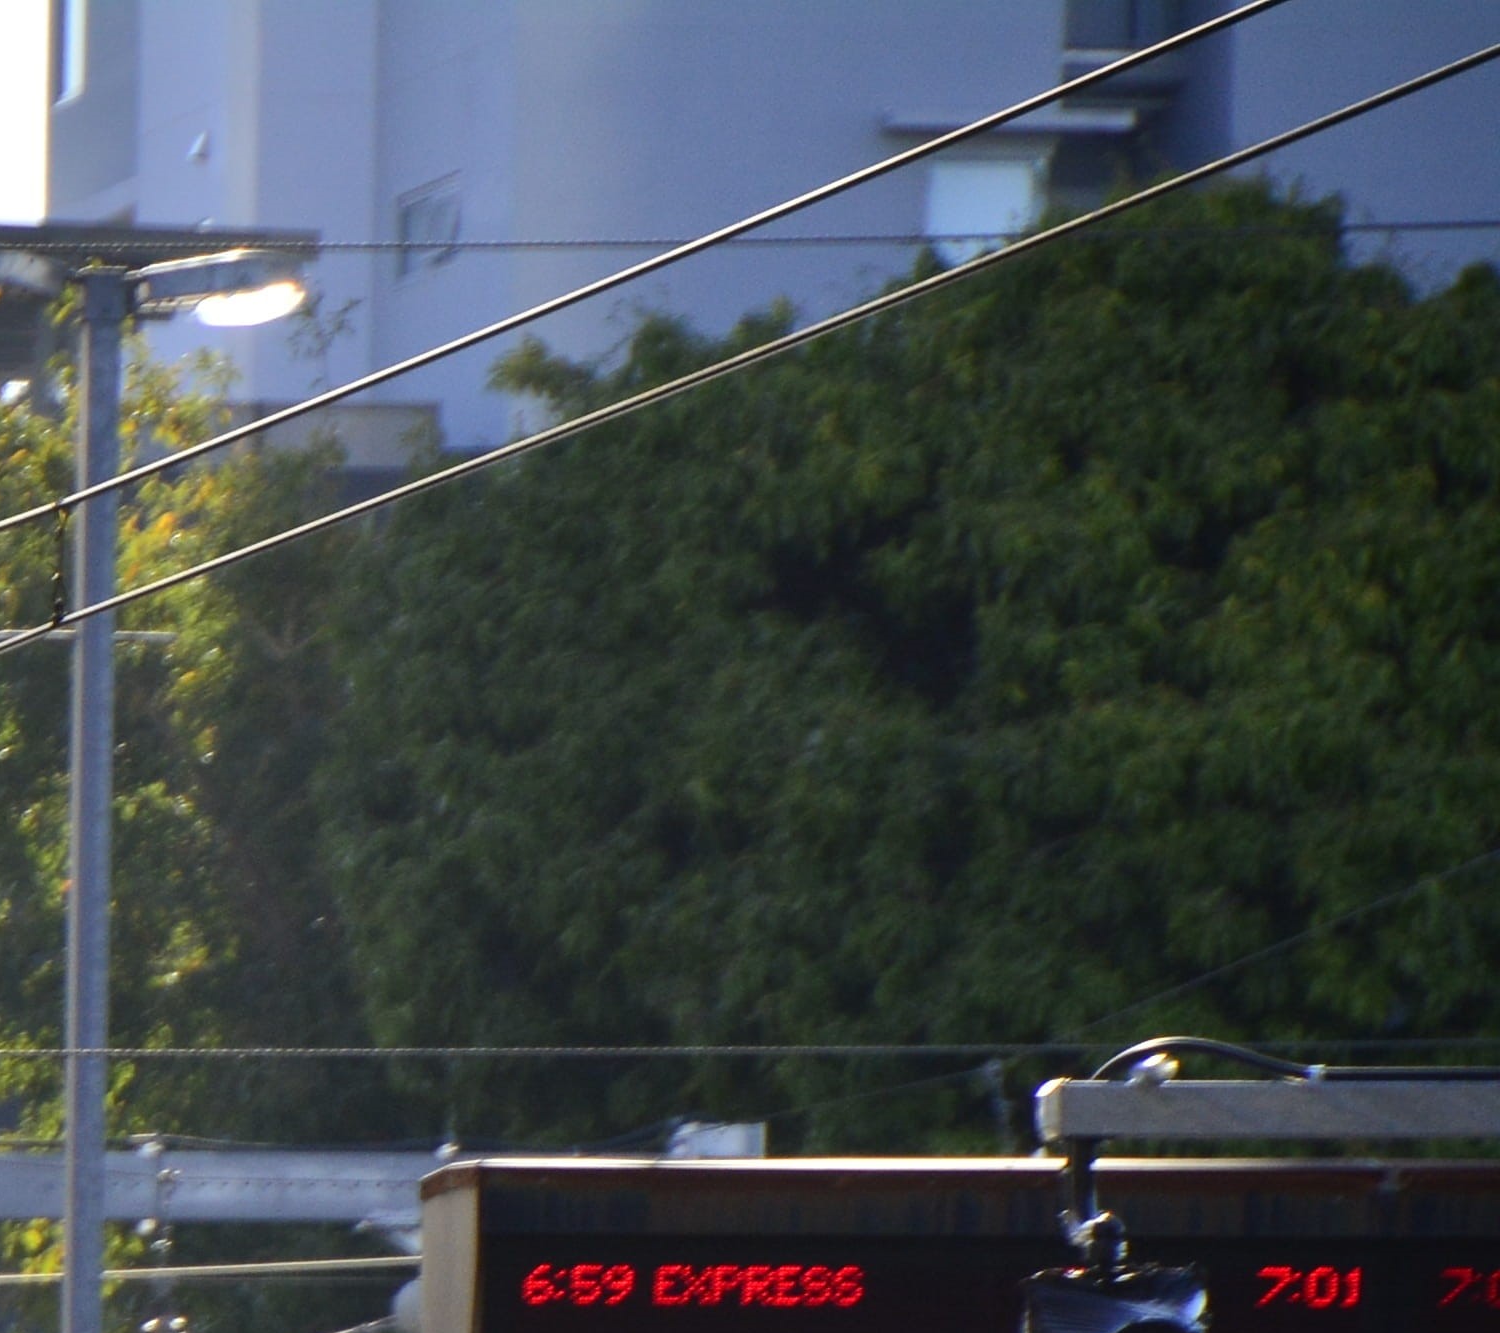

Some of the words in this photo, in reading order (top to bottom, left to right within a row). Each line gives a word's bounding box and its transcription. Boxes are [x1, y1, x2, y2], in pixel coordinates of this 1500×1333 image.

[522, 1263, 636, 1305] 6:59
[652, 1263, 864, 1308] EXPRESS
[1254, 1265, 1362, 1309] 7:01
